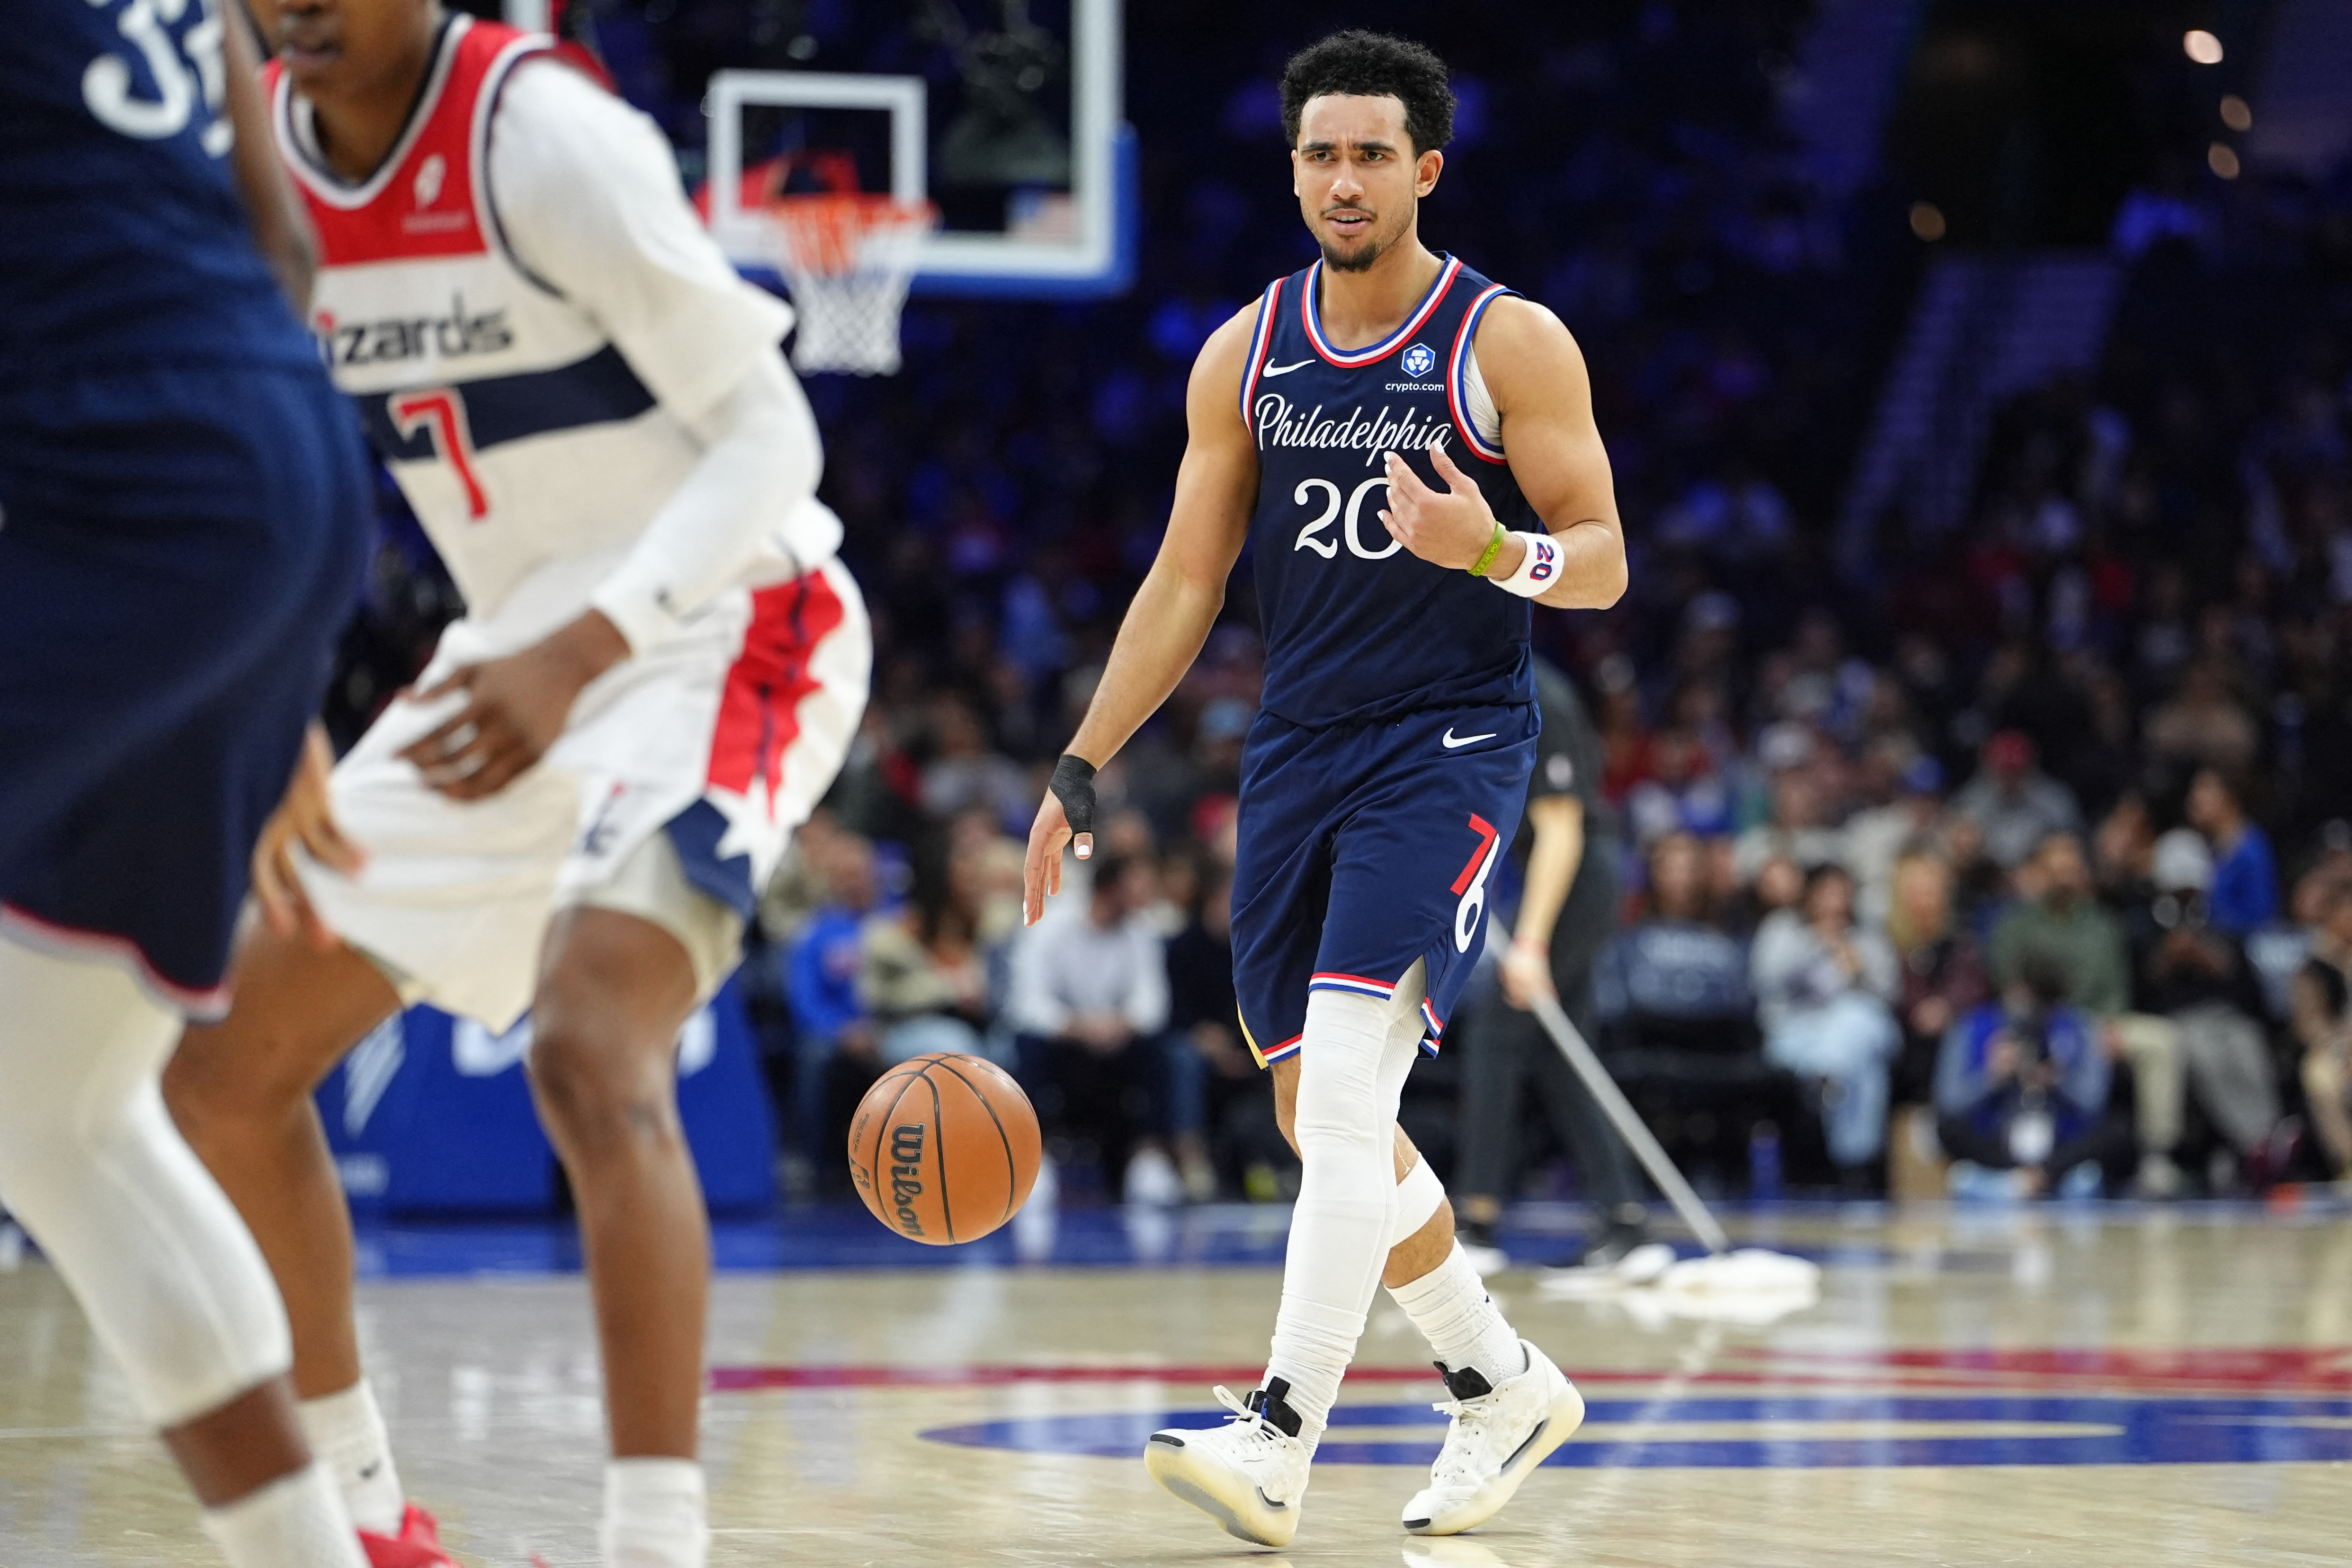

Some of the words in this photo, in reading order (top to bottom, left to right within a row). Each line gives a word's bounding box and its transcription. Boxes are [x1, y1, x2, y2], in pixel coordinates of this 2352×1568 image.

[314, 290, 514, 367] izards
[1385, 382, 1444, 392] crypto.com
[388, 388, 490, 521] 7
[1255, 393, 1452, 467] Philadelphia
[1294, 477, 1403, 560] 20
[1529, 541, 1555, 581] 20
[1450, 813, 1500, 953] 76
[890, 1122, 925, 1237] Wilson
